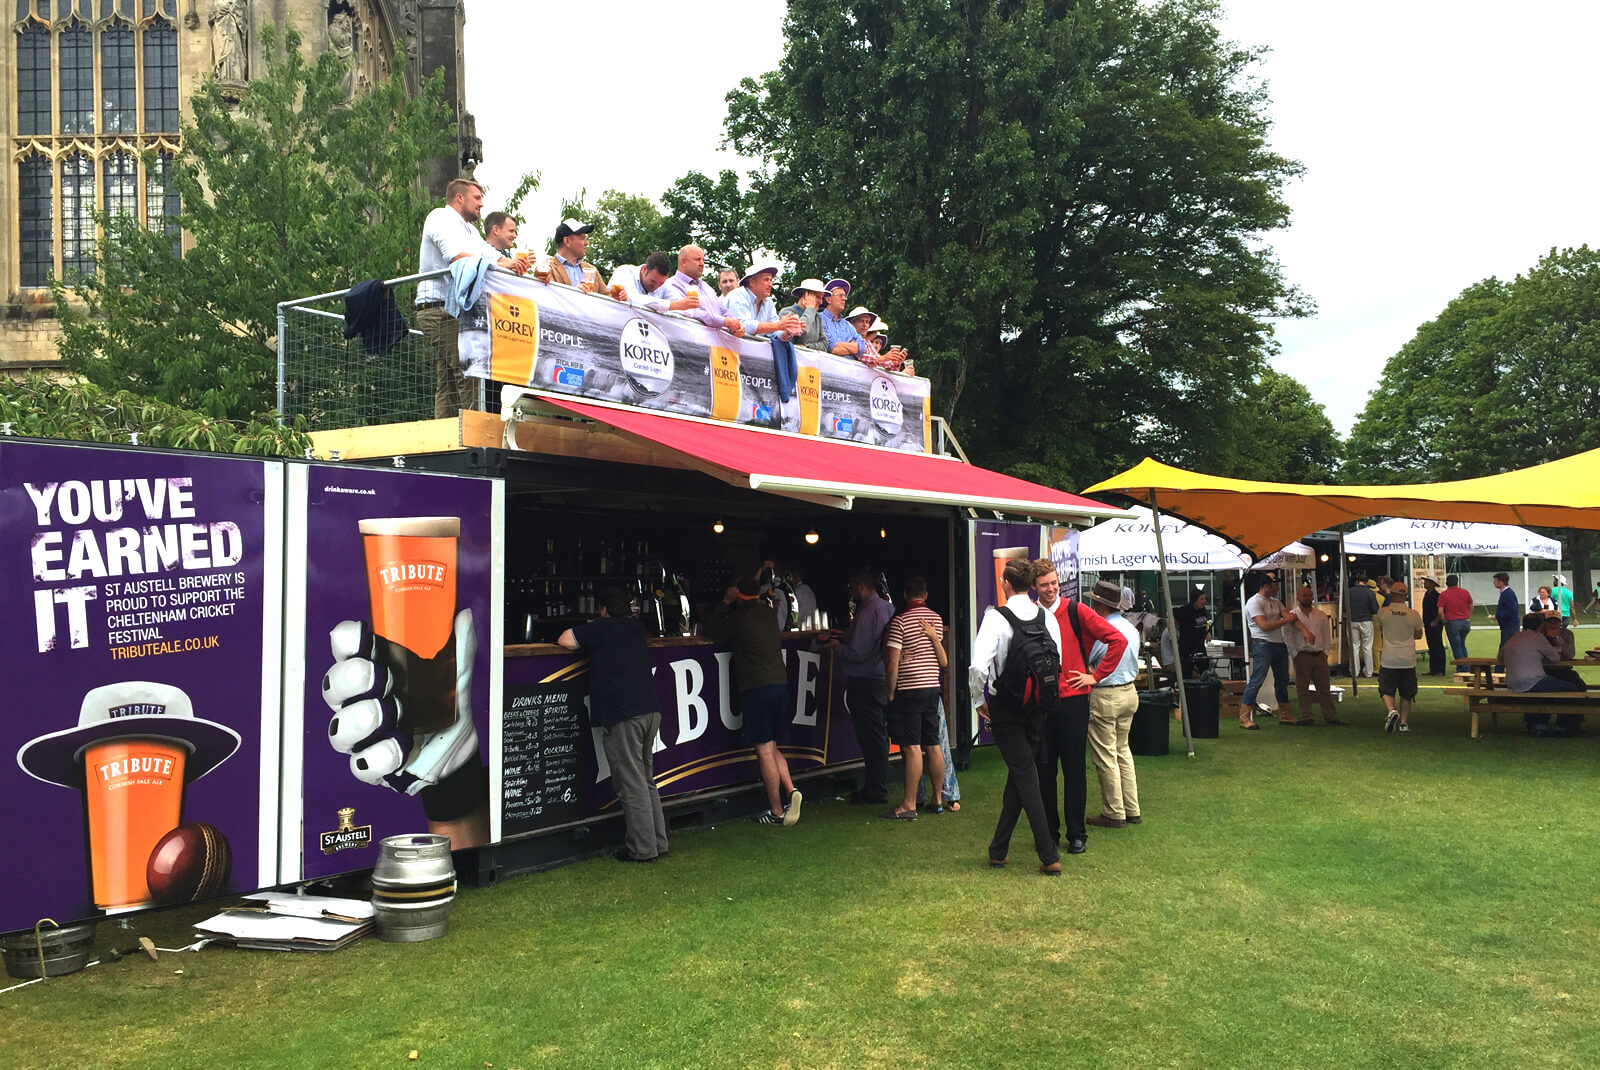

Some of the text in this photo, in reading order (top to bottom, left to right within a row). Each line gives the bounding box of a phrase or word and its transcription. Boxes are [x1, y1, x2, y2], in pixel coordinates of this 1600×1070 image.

[494, 318, 535, 338] KOREV
[540, 328, 585, 349] PEOPLE
[624, 342, 670, 366] KOREV
[740, 374, 772, 389] PEOPLE
[822, 390, 852, 403] PEOPLE
[324, 486, 376, 496] drinkaware.co.uk
[24, 477, 196, 526] YOU'VE
[31, 521, 243, 582] EARNED
[1370, 542, 1410, 550] Cornish
[1414, 541, 1444, 552] Lager
[1080, 552, 1209, 567] rnish Lager wth Soul
[380, 564, 444, 584] TRIBUTE
[104, 572, 246, 597] ST AUSTELL BREWERY IS
[106, 586, 246, 613] PROUD TO SUPPORT THE
[34, 585, 98, 653] IT
[107, 602, 236, 629] CHELTENHAM CRICKET
[108, 627, 164, 645] FESTIVAL
[110, 635, 220, 660] TRIBUTEALE.CO.UK
[512, 693, 568, 708] DRINKS MENU
[111, 704, 164, 718] TRIBUTE
[544, 705, 568, 716] SPIRITS
[544, 744, 574, 755] COCKTAILS
[100, 757, 172, 780] TRIBUTE
[504, 766, 522, 776] WINE
[504, 788, 522, 799] WINE
[334, 830, 368, 844] AUSTELL
